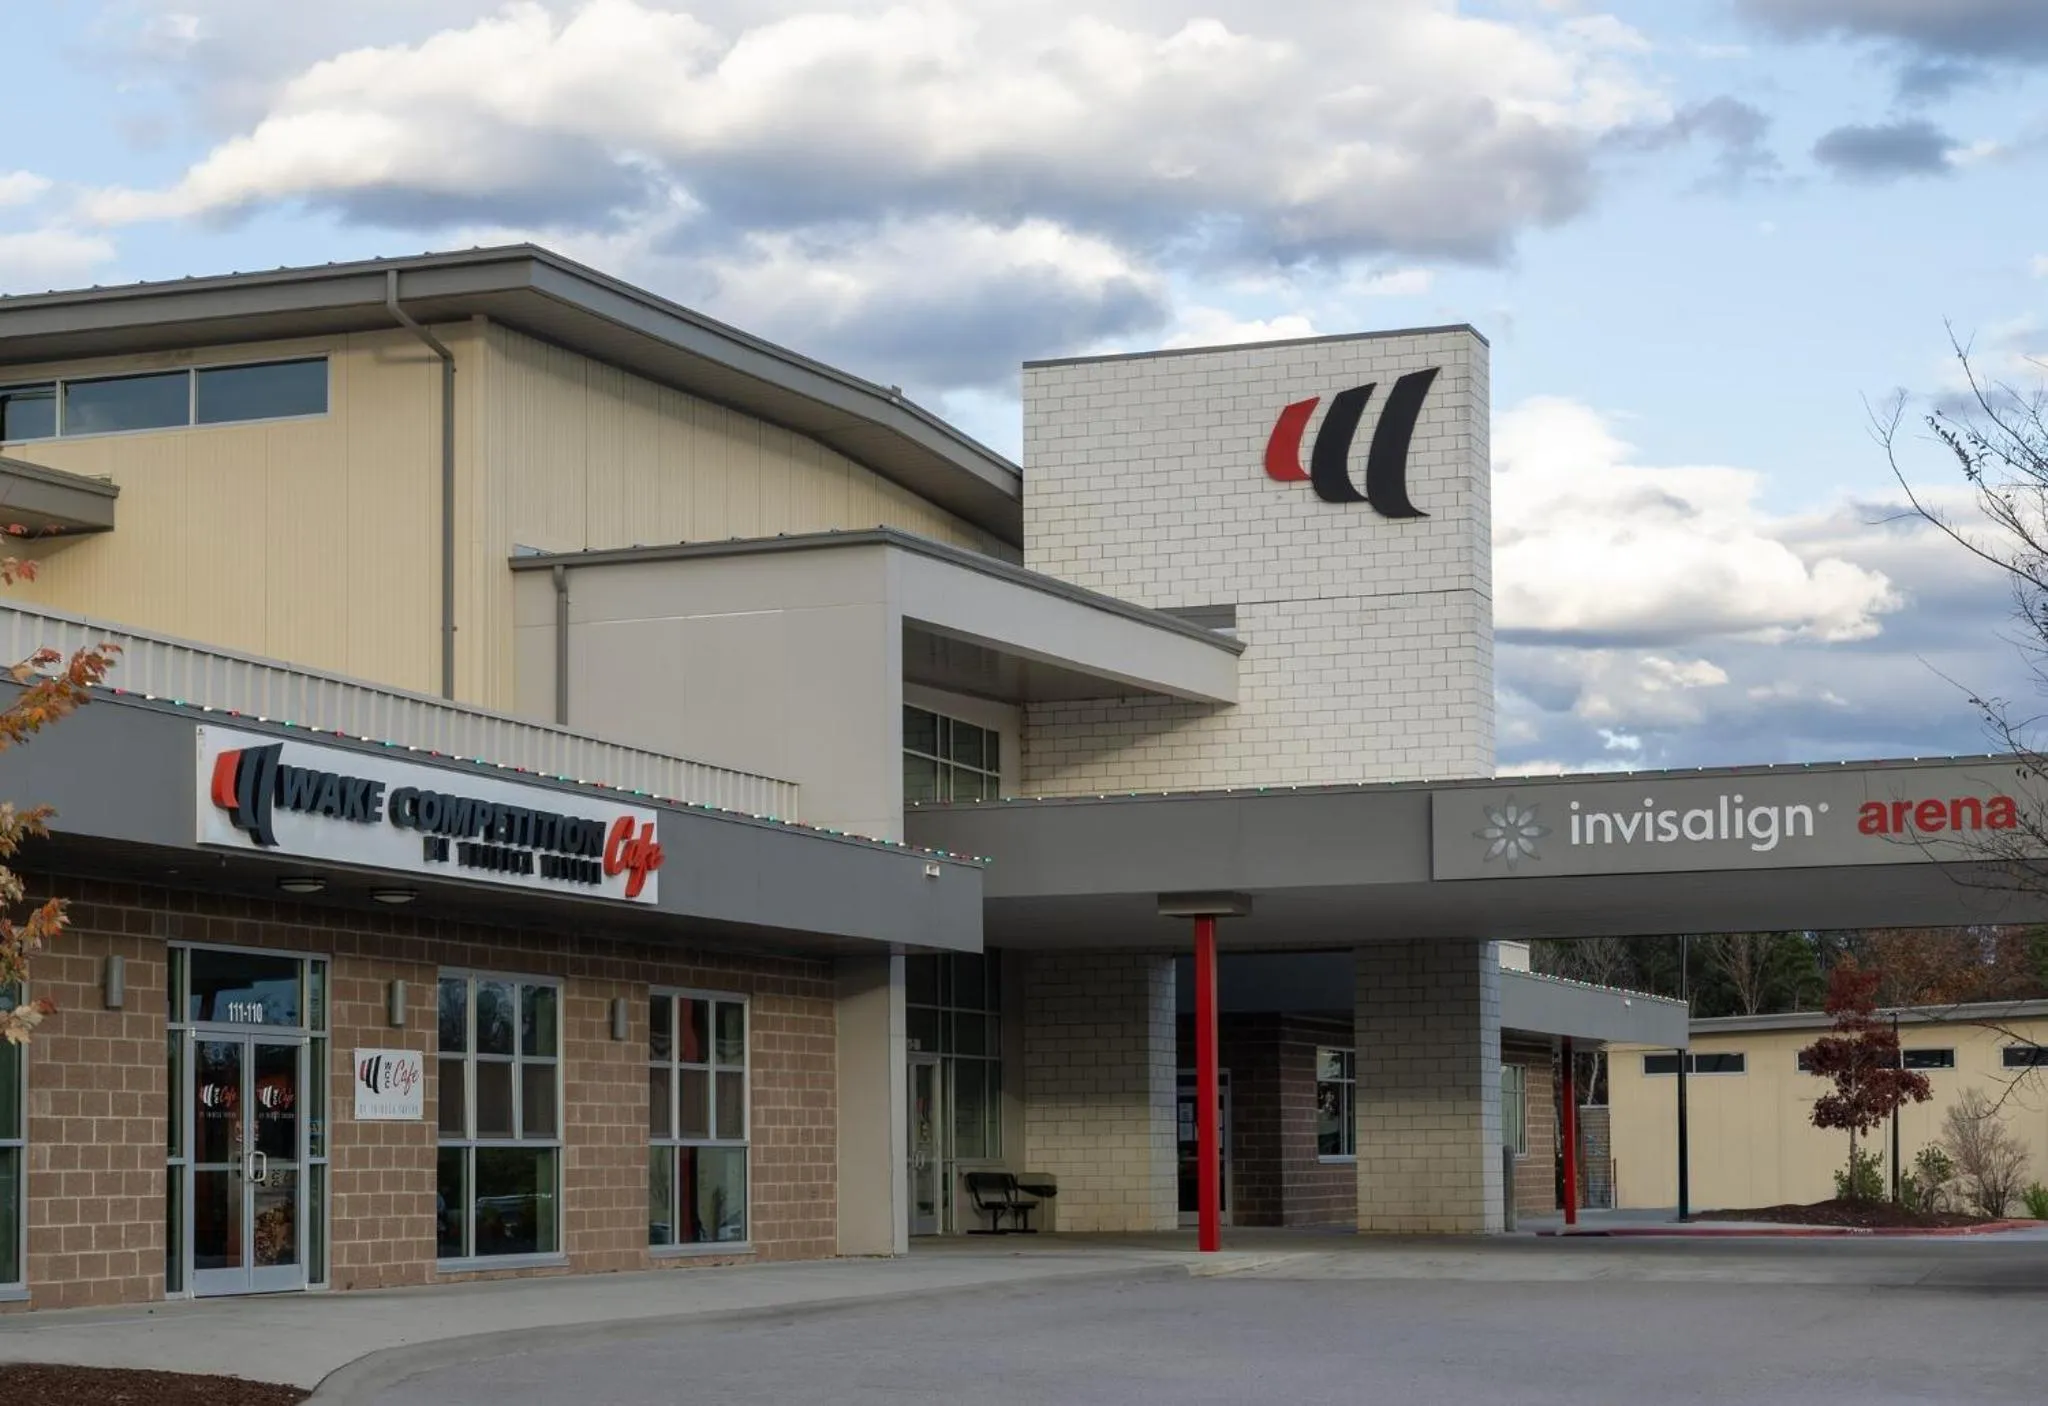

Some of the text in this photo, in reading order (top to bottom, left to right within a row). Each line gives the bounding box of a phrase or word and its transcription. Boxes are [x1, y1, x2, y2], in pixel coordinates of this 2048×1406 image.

[275, 764, 386, 823] WAKE
[388, 786, 606, 858] COMPETITION
[1857, 795, 2017, 835] arena
[228, 1002, 263, 1023] 111-110
